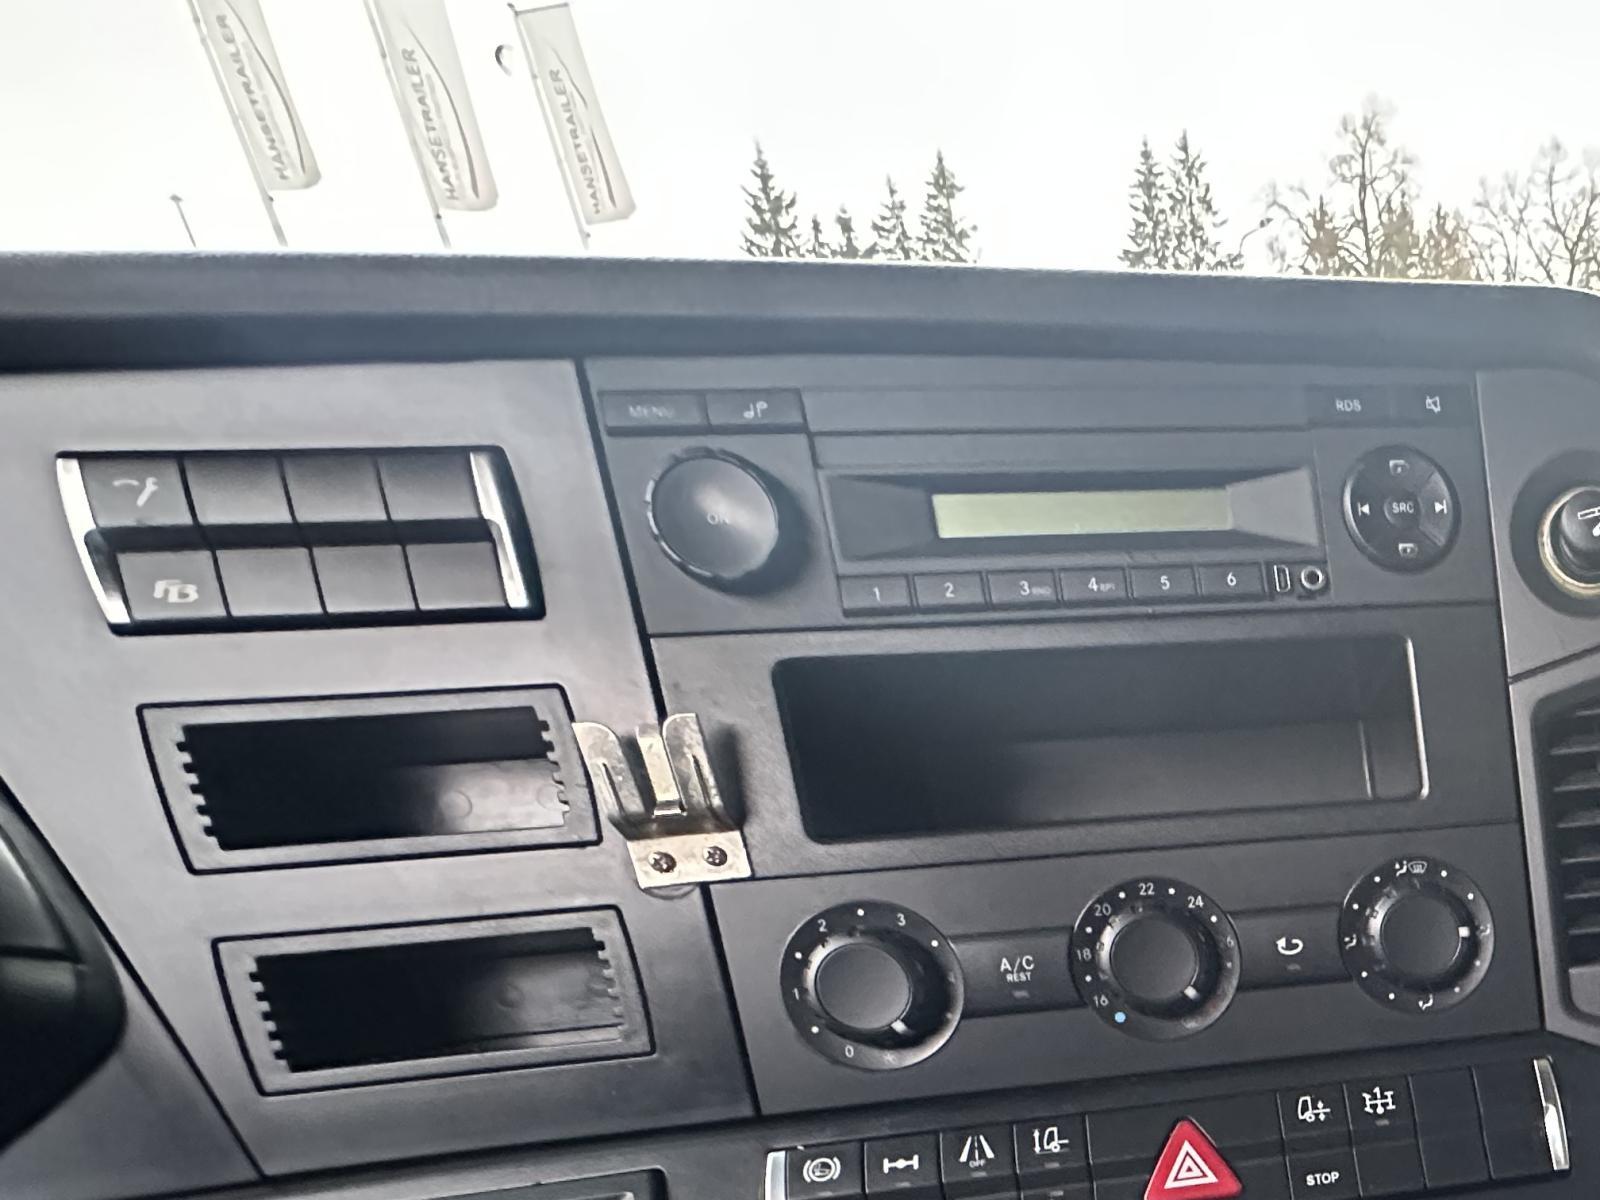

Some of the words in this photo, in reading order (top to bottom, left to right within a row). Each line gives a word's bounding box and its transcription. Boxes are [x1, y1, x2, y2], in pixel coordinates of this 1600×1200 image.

[401, 47, 459, 201] HANSETRAILER
[549, 68, 601, 215] HANSETRAILER
[1336, 399, 1362, 412] RDS
[1392, 501, 1415, 514] SRC
[1087, 577, 1099, 592] 4
[1160, 575, 1171, 590] 5
[1226, 572, 1237, 586] 6
[872, 587, 881, 601] 1
[944, 582, 955, 598] 2
[1019, 580, 1030, 596] 3
[1138, 882, 1155, 896] 22
[1187, 895, 1204, 908] 24
[1093, 903, 1112, 917] 20
[817, 918, 827, 933] 2
[896, 913, 907, 927] 3
[1077, 947, 1093, 961] 18
[999, 955, 1035, 974] A/C
[1005, 972, 1032, 983] REST
[792, 988, 801, 1001] 1
[1093, 994, 1109, 1008] 16
[844, 1045, 855, 1059] 0
[1305, 1171, 1340, 1186] STOP
